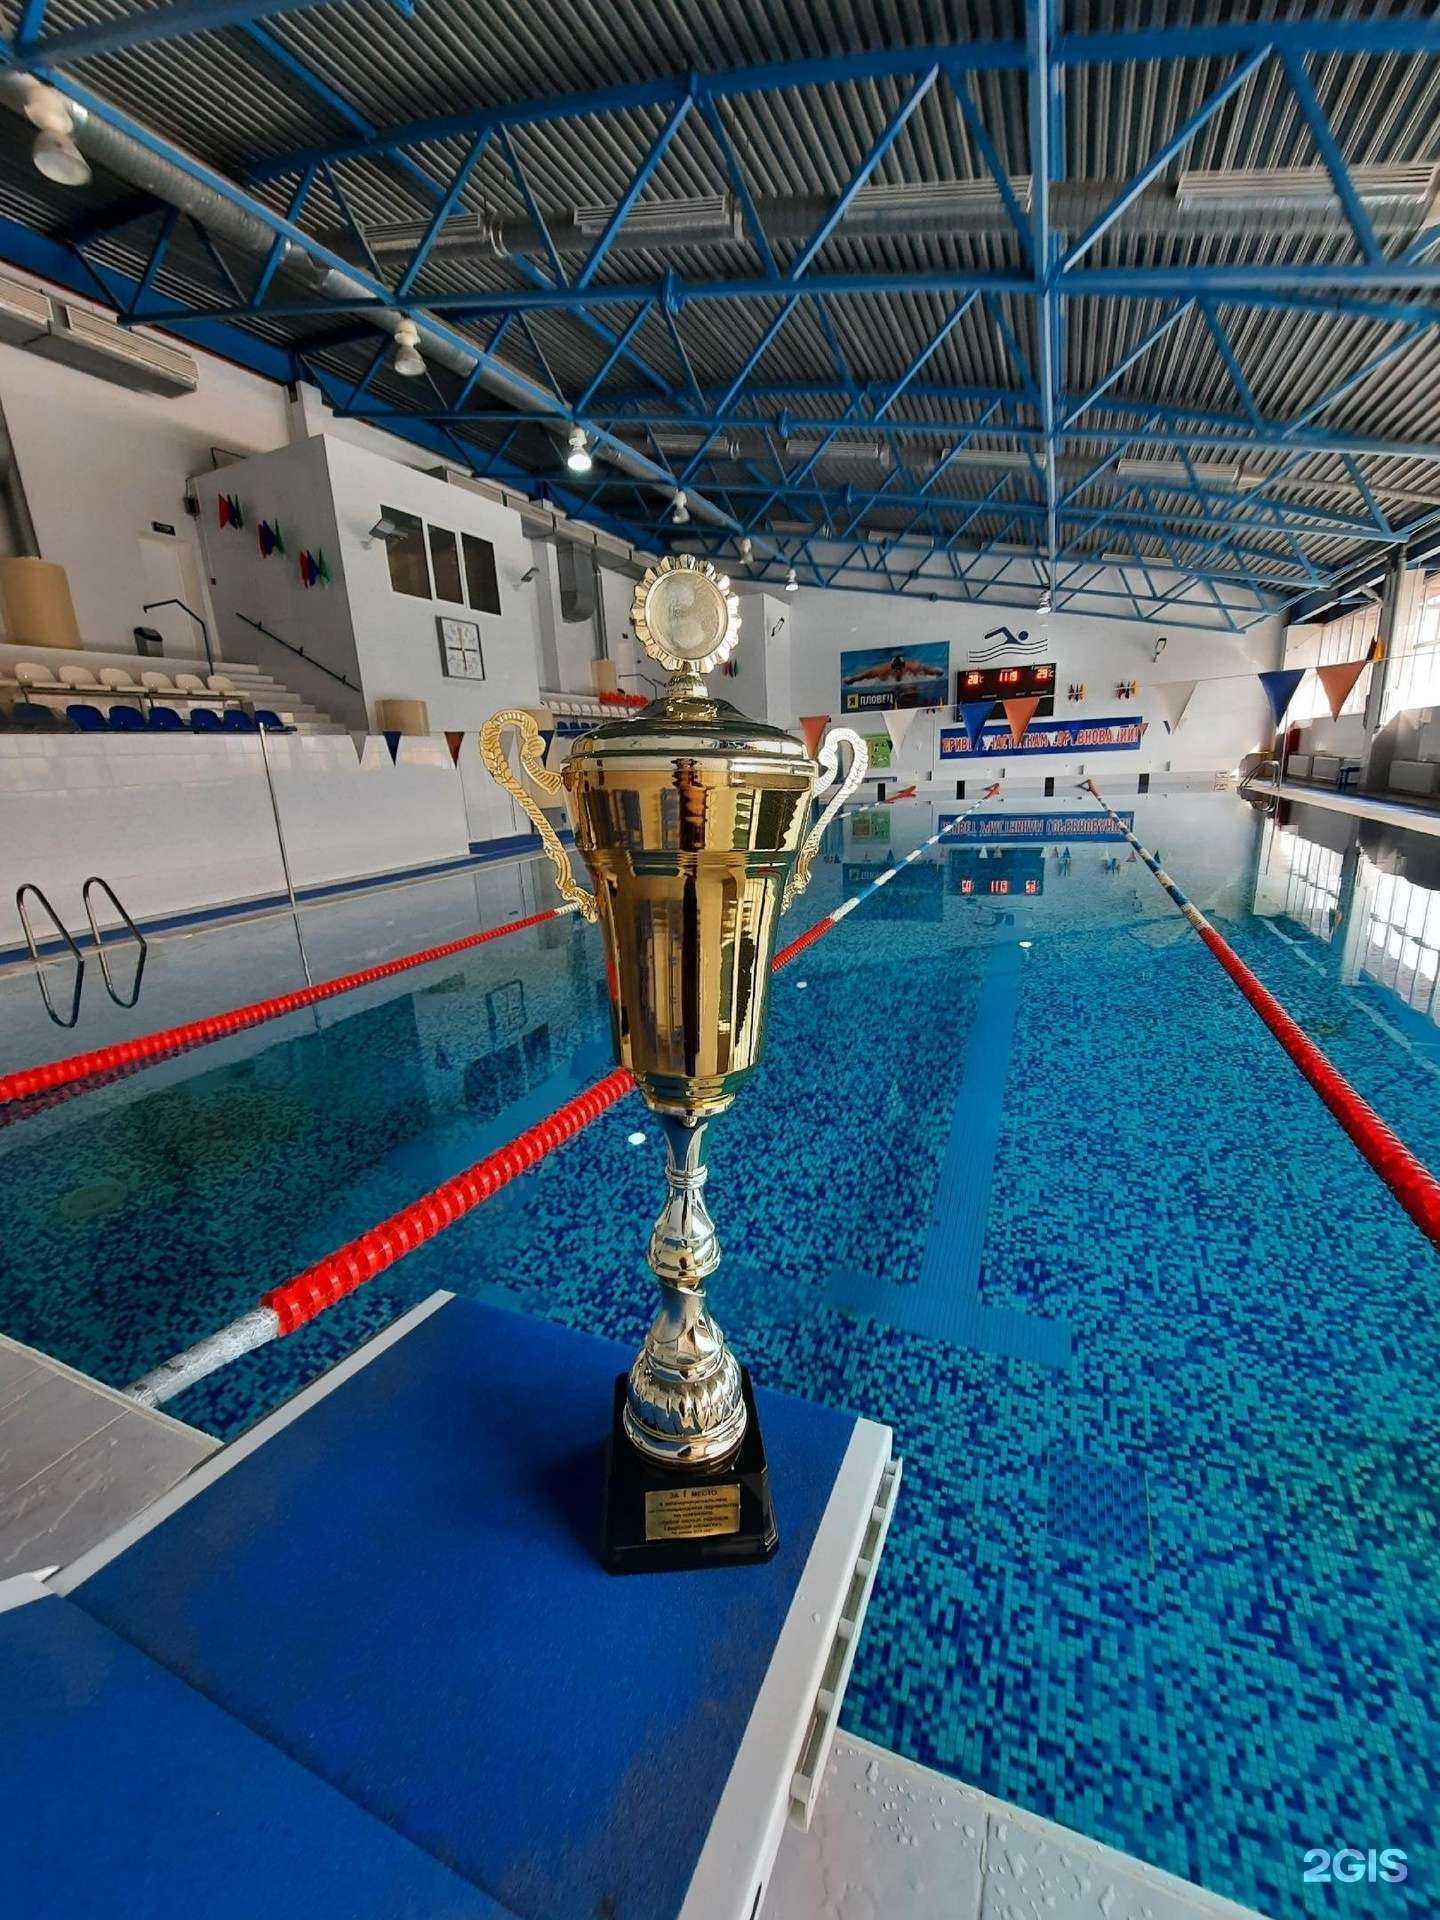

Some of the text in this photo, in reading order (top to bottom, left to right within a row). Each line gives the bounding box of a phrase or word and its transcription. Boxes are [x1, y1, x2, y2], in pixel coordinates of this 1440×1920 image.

[942, 724, 1138, 753] ПРИВЕ ЧАСТКАМ ОРВНОВАИЙ
